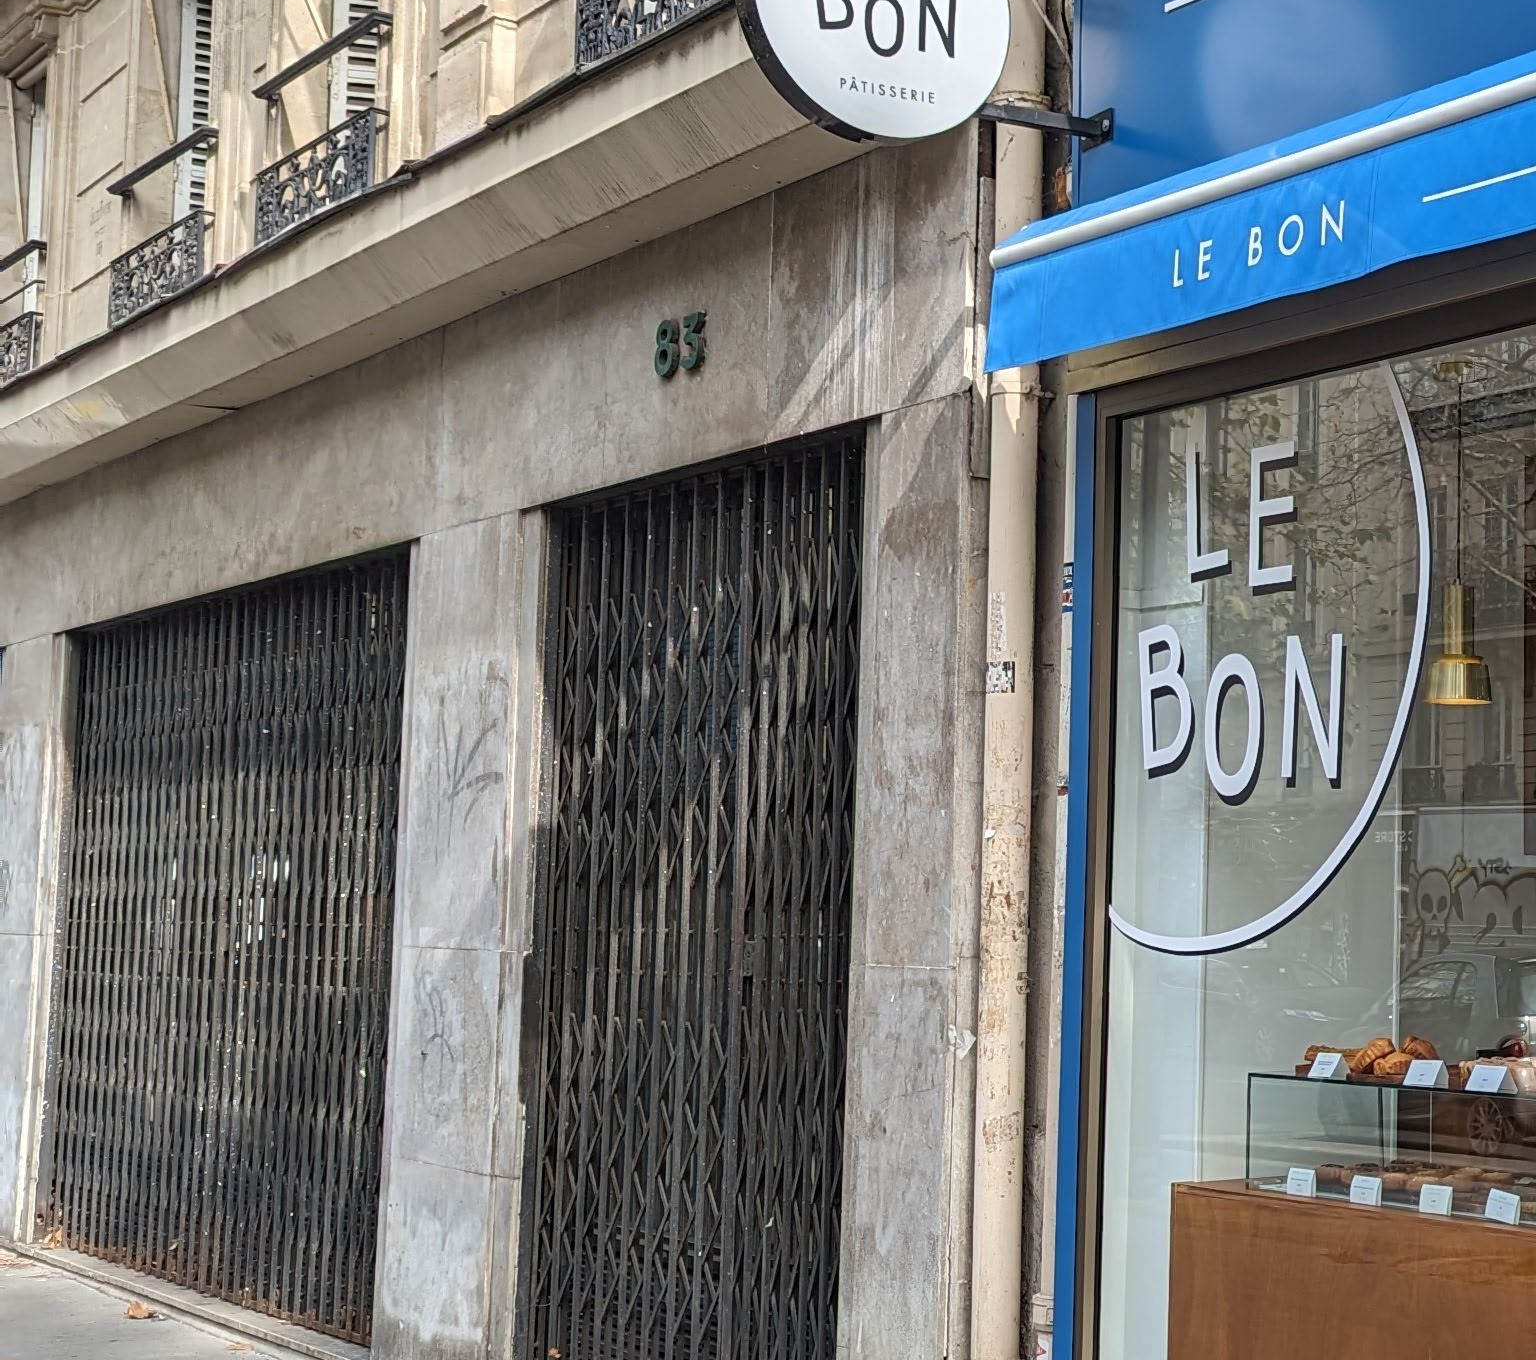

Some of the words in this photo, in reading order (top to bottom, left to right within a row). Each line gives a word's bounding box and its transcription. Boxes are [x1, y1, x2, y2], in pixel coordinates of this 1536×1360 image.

[839, 76, 936, 105] PÂTISSERIE
[1172, 239, 1214, 288] LE
[1248, 200, 1346, 268] BON
[655, 311, 706, 378] 83
[1186, 441, 1297, 594] LE
[1138, 623, 1346, 804] BON
